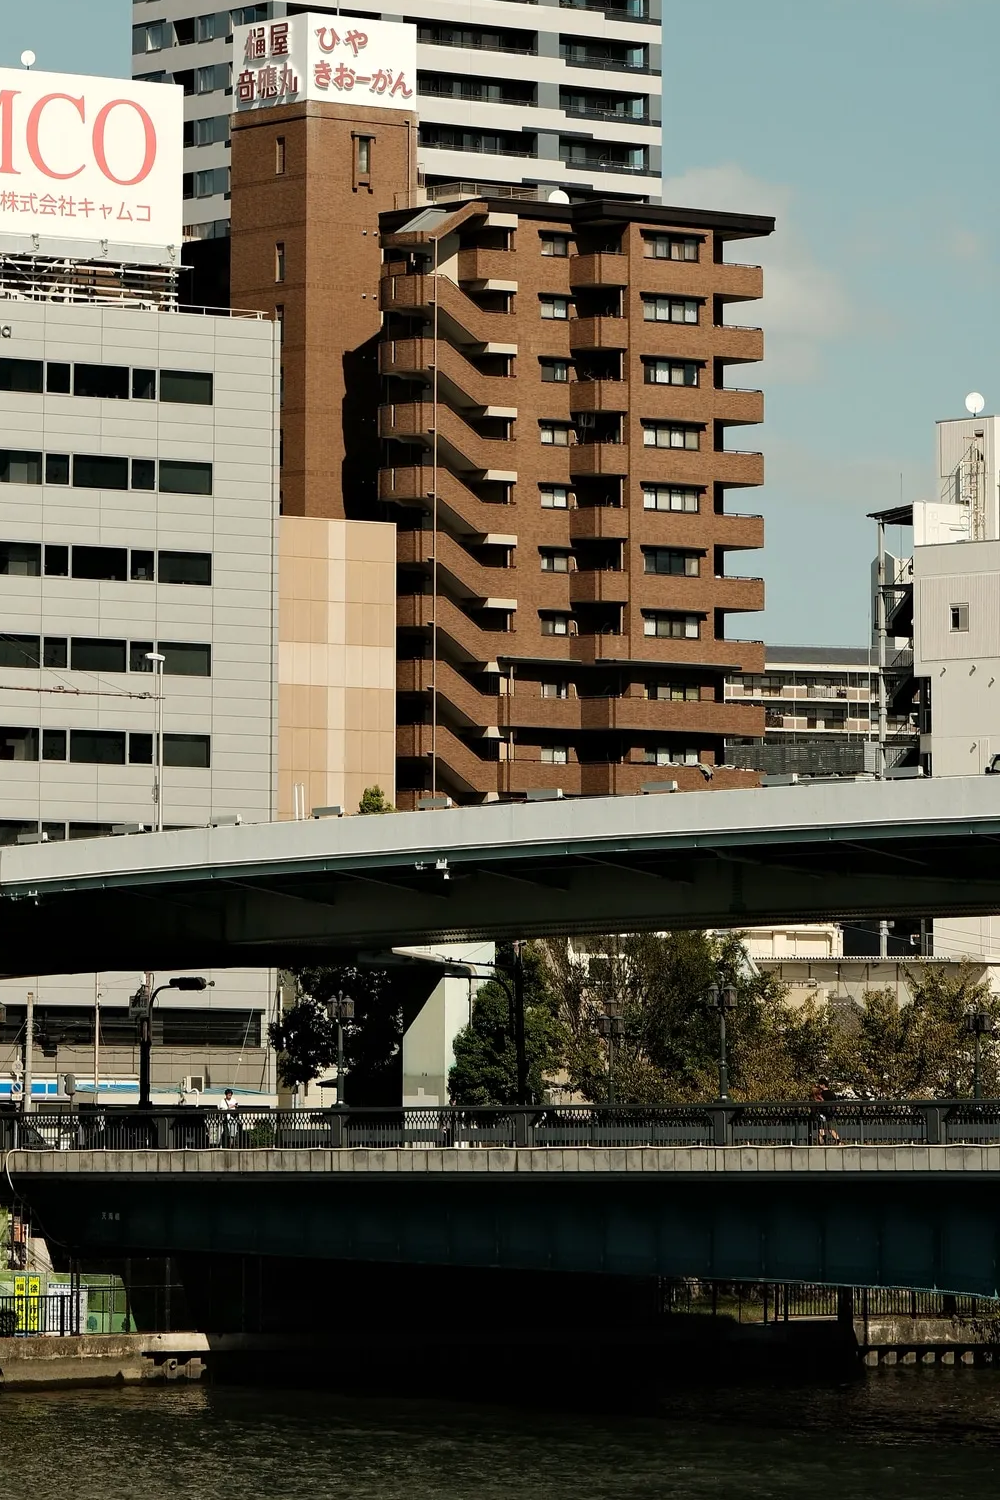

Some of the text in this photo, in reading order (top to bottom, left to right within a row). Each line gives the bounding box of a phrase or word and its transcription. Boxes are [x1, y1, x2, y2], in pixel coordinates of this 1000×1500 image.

[316, 26, 369, 55] ひや
[314, 59, 413, 96] きおーがん
[0, 190, 151, 222] 株式会社キャムコ
